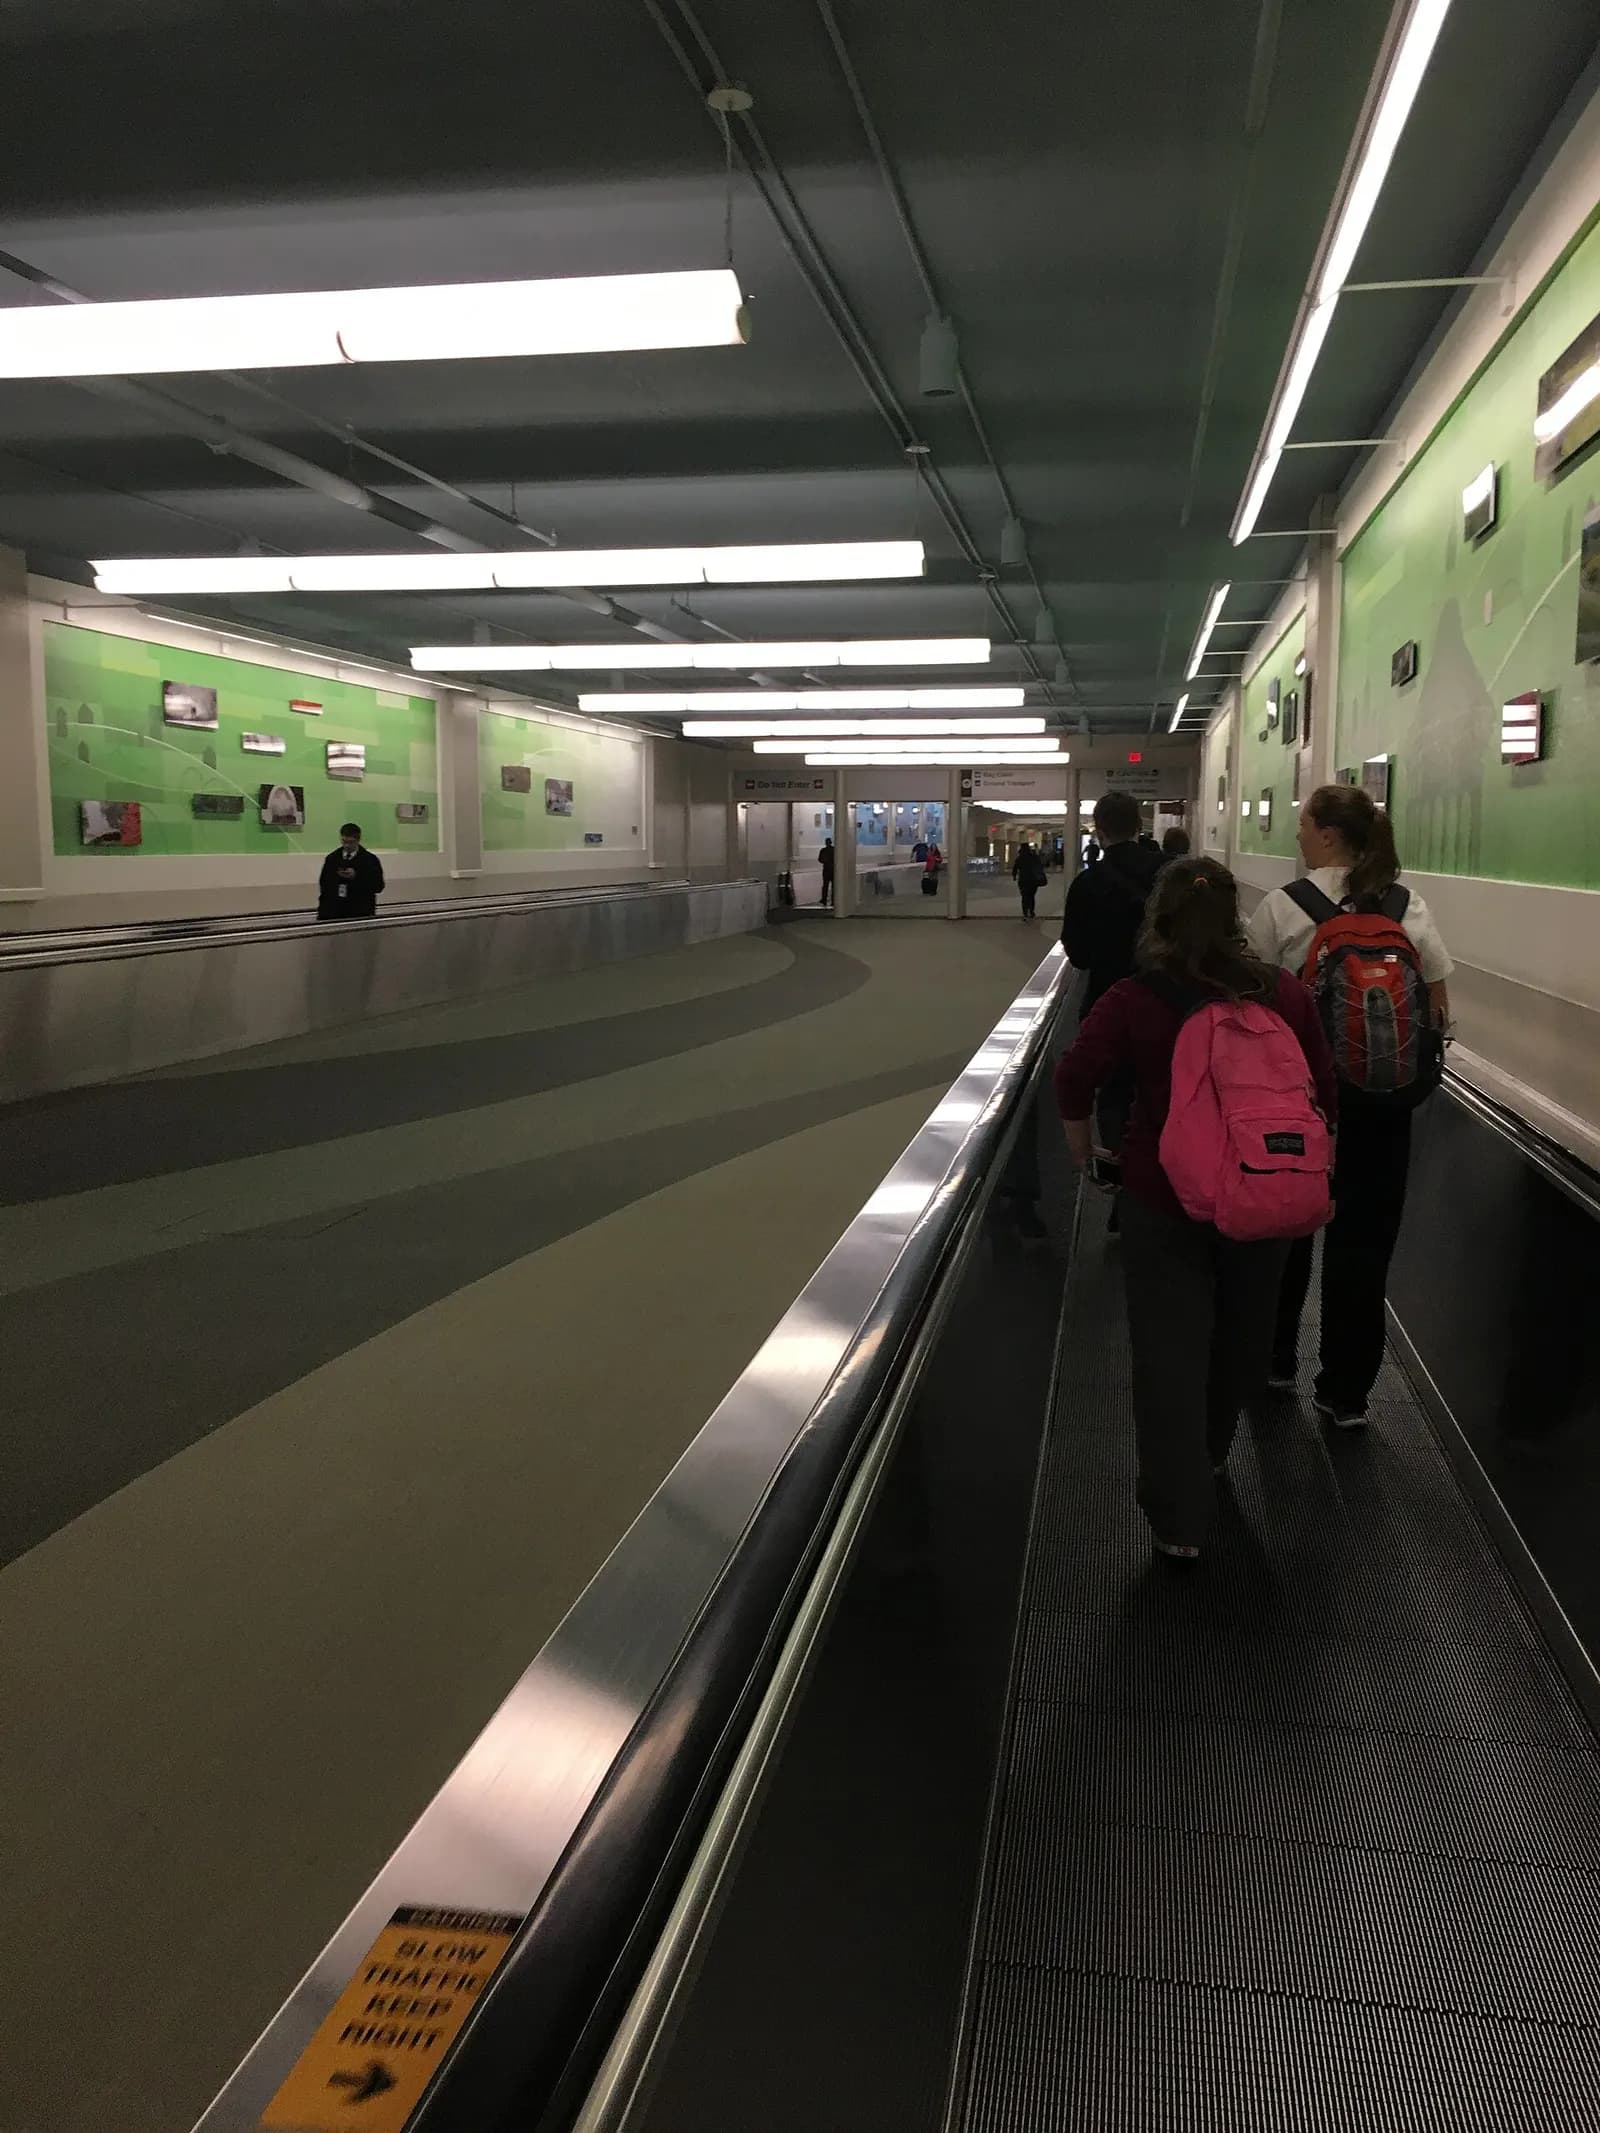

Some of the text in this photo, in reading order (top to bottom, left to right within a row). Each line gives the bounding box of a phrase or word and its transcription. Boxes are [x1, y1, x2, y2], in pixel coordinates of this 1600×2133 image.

[757, 780, 769, 790] Do
[787, 780, 811, 790] Enter
[397, 1940, 487, 1963] SLOW
[364, 1994, 453, 2017] KEEP
[339, 2022, 442, 2050] RIGHT
